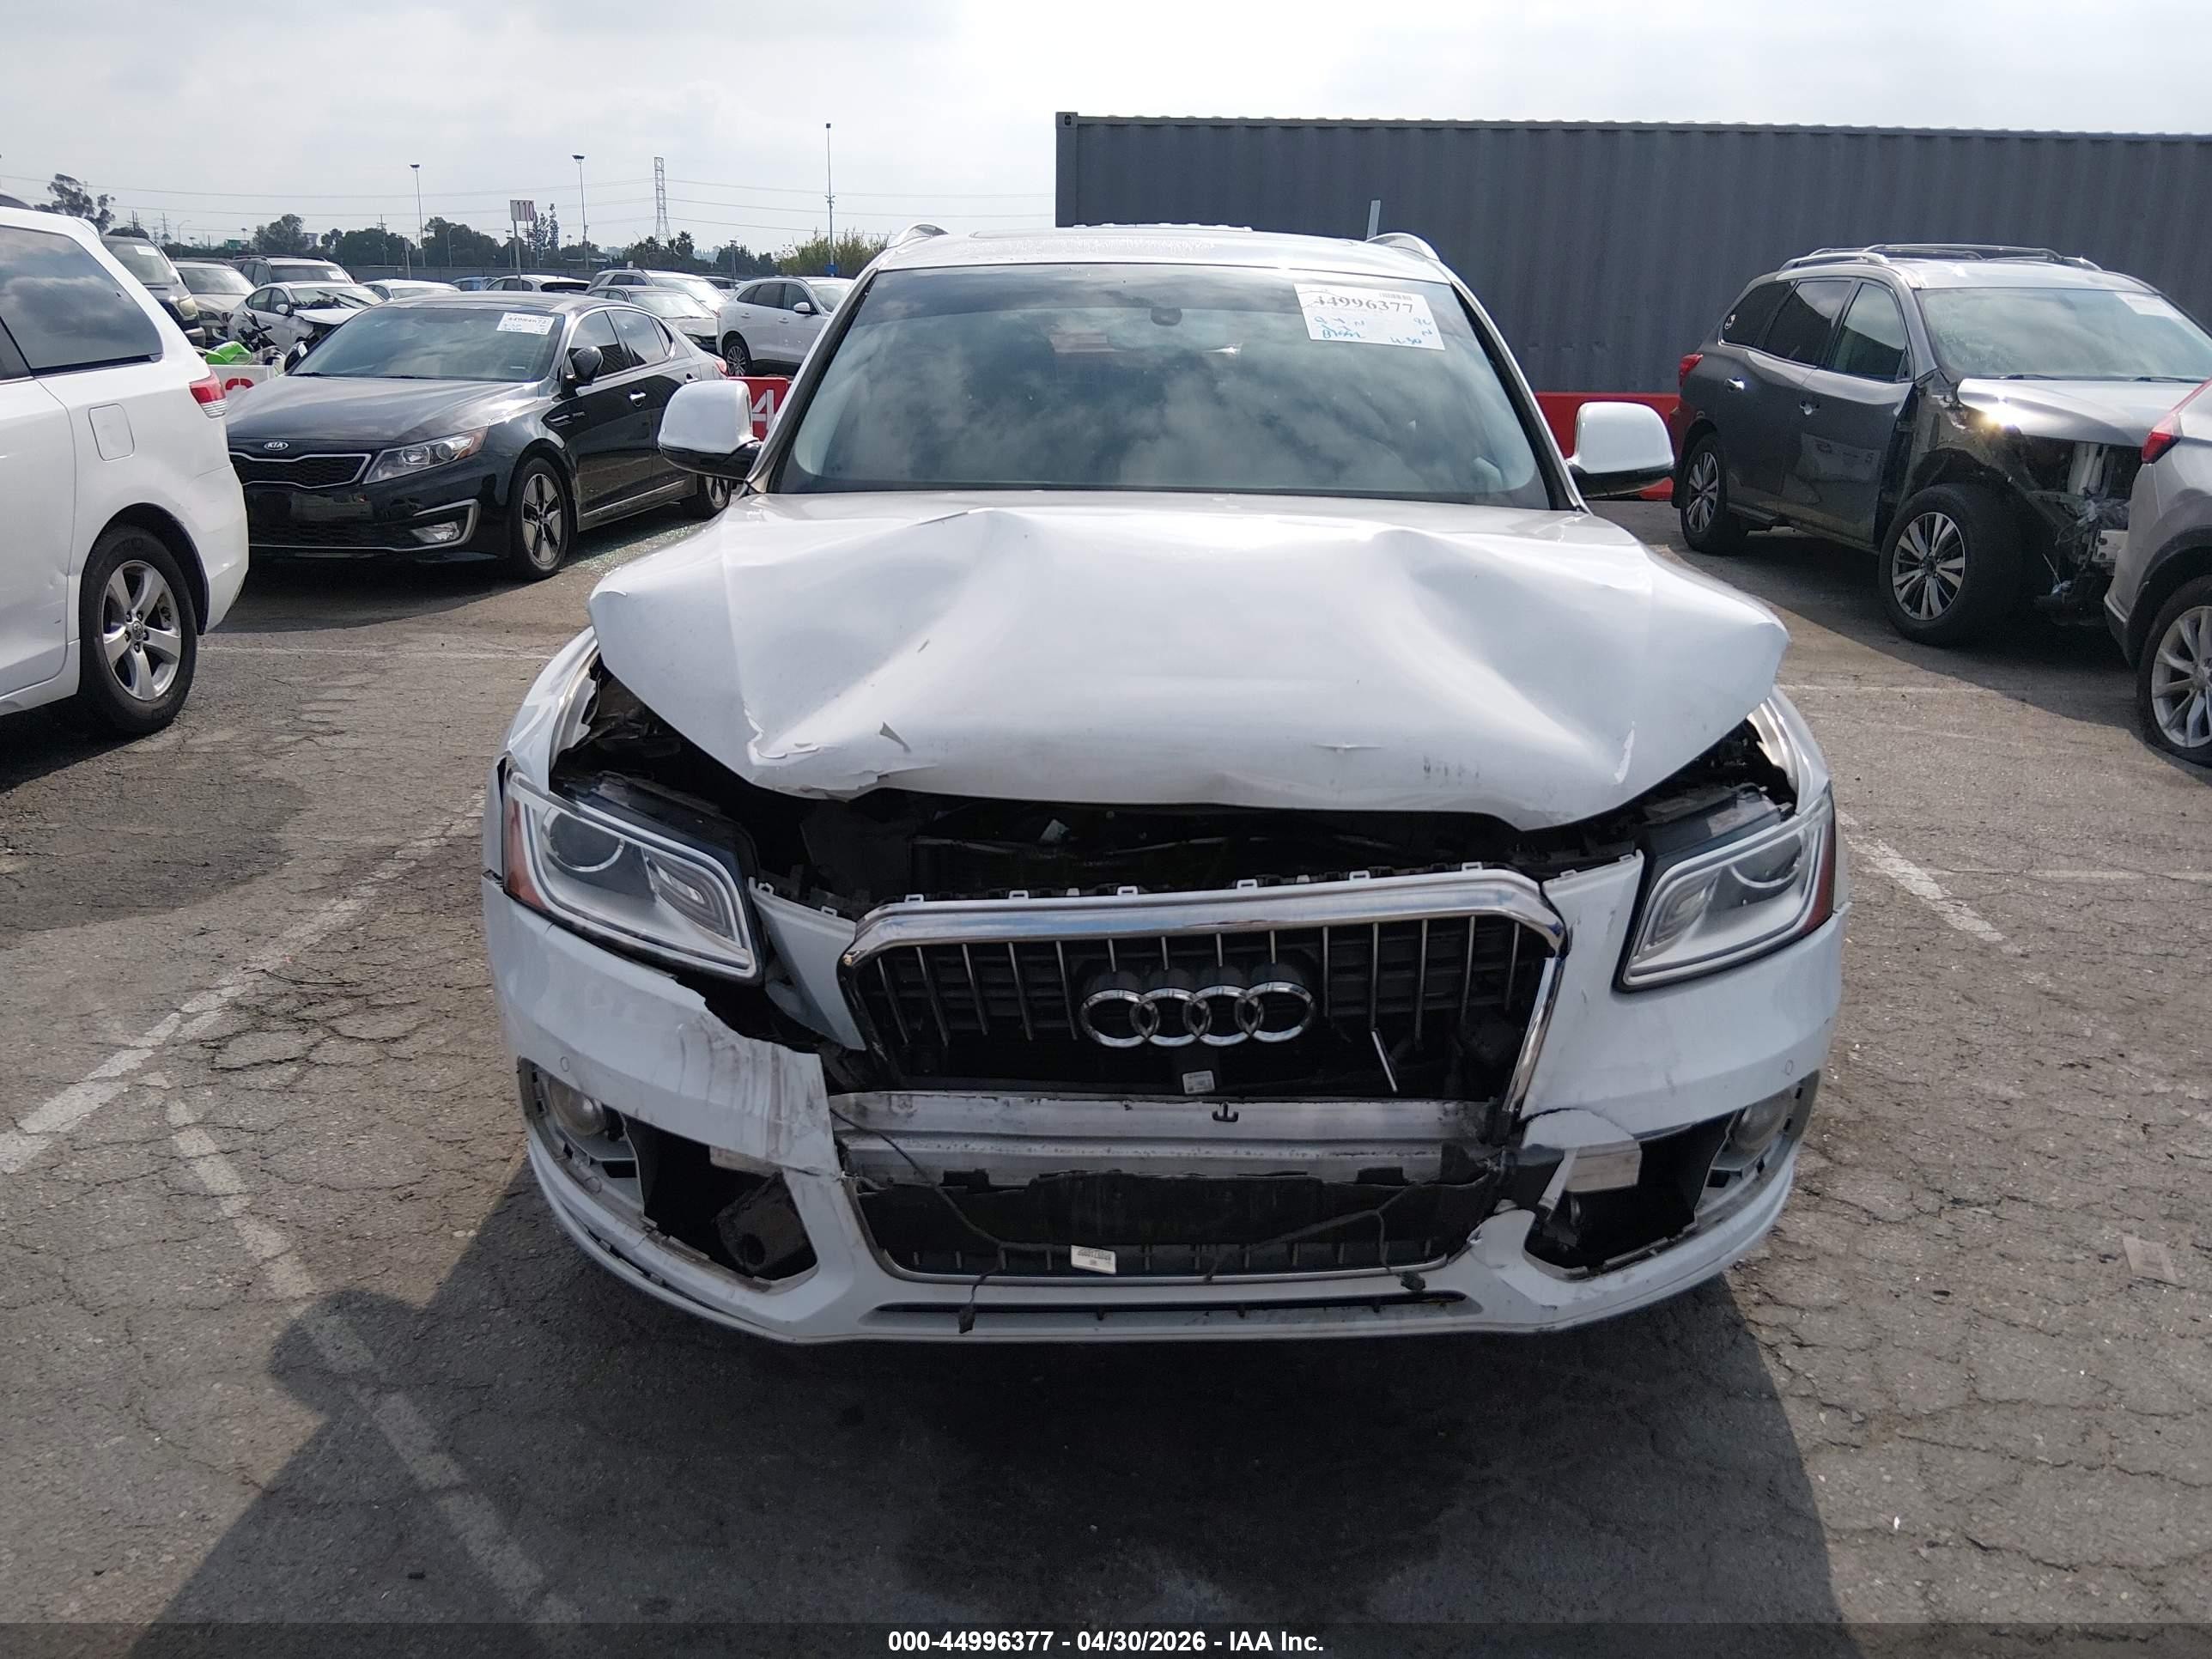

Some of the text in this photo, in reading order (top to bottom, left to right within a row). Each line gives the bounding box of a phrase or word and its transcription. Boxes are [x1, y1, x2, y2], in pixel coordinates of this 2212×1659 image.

[517, 201, 535, 221] 110
[1313, 295, 1413, 313] 44996377
[752, 389, 776, 430] 4
